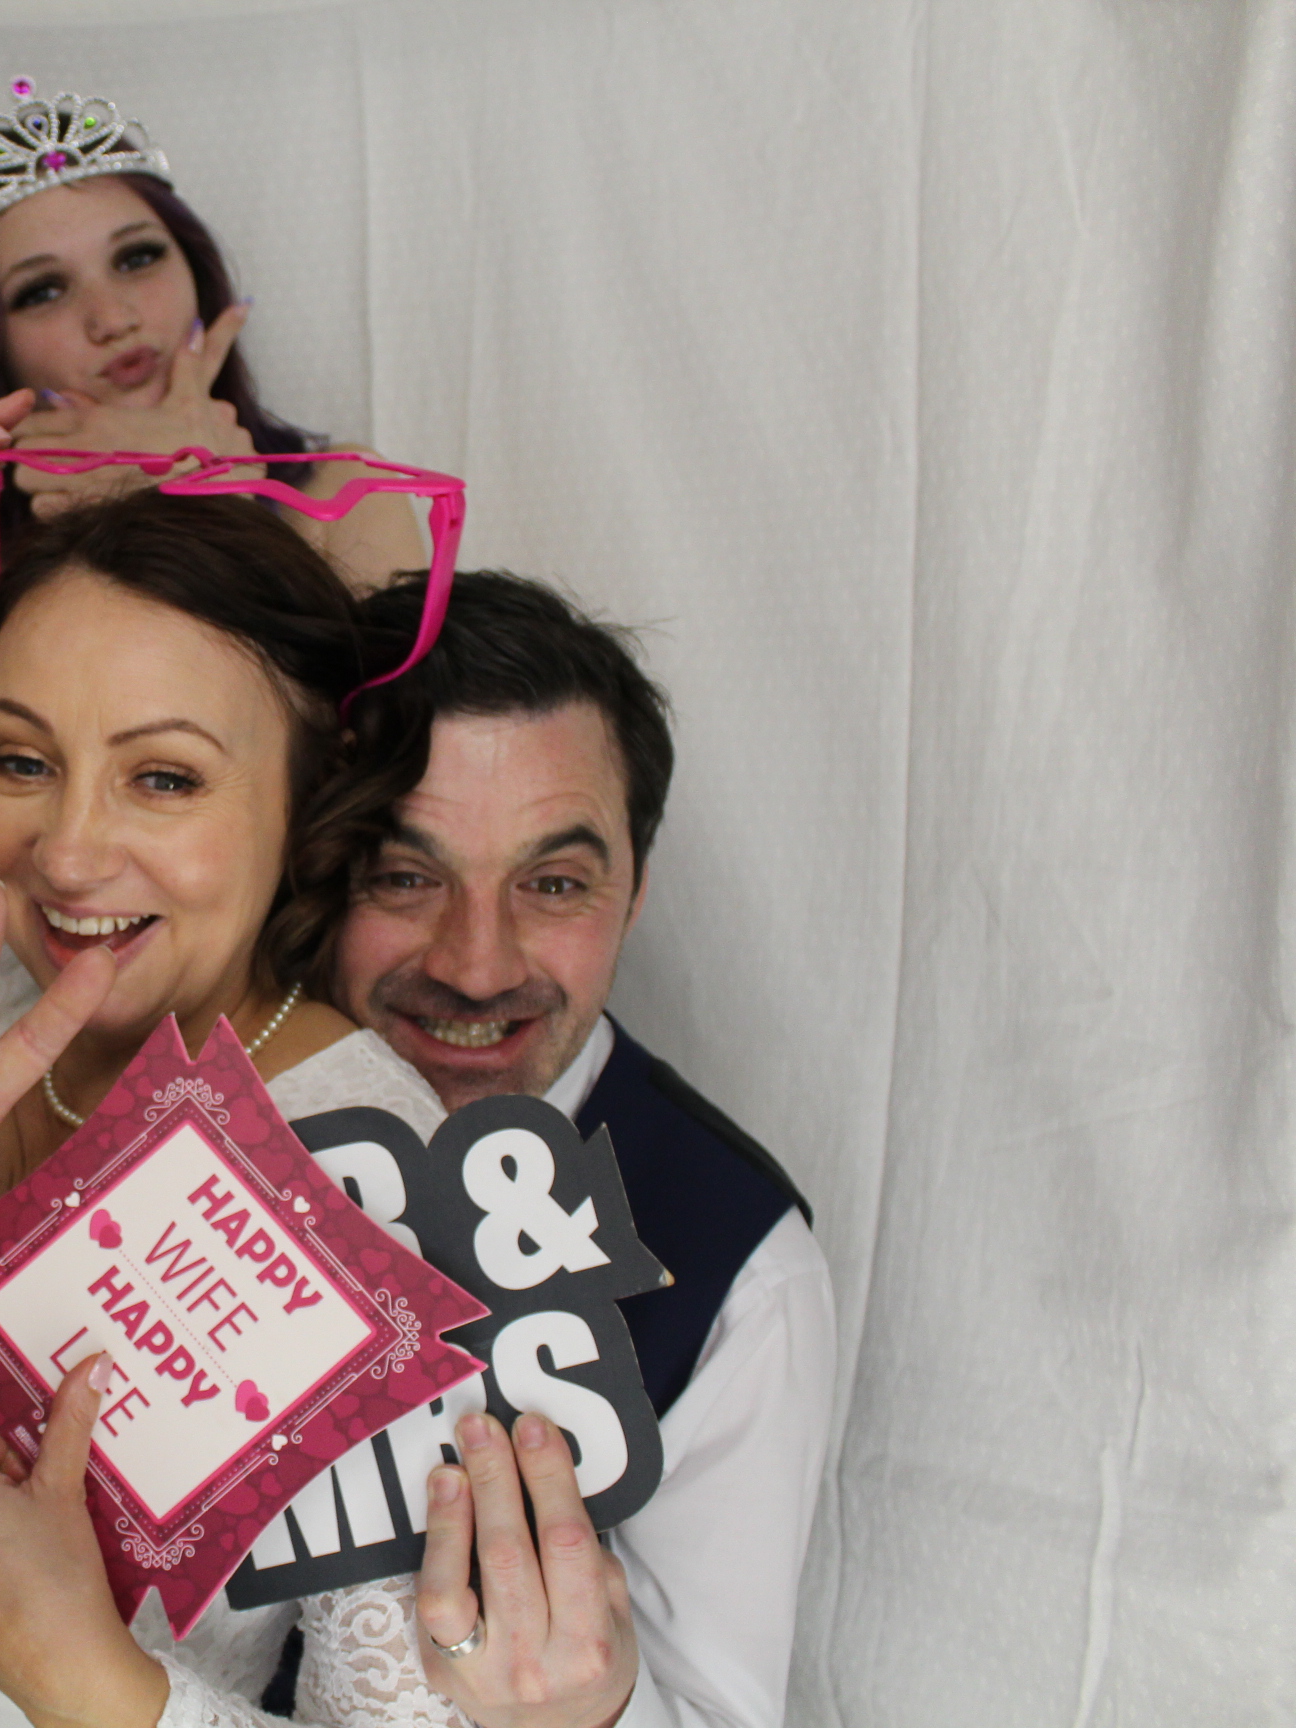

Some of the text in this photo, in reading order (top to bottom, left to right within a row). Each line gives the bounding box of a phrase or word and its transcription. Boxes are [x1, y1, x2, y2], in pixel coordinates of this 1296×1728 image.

[187, 1174, 324, 1315] HAPPY
[462, 1128, 611, 1290] &
[87, 1265, 221, 1408] HAPPY
[145, 1221, 259, 1352] WIFE
[50, 1326, 151, 1437] LE
